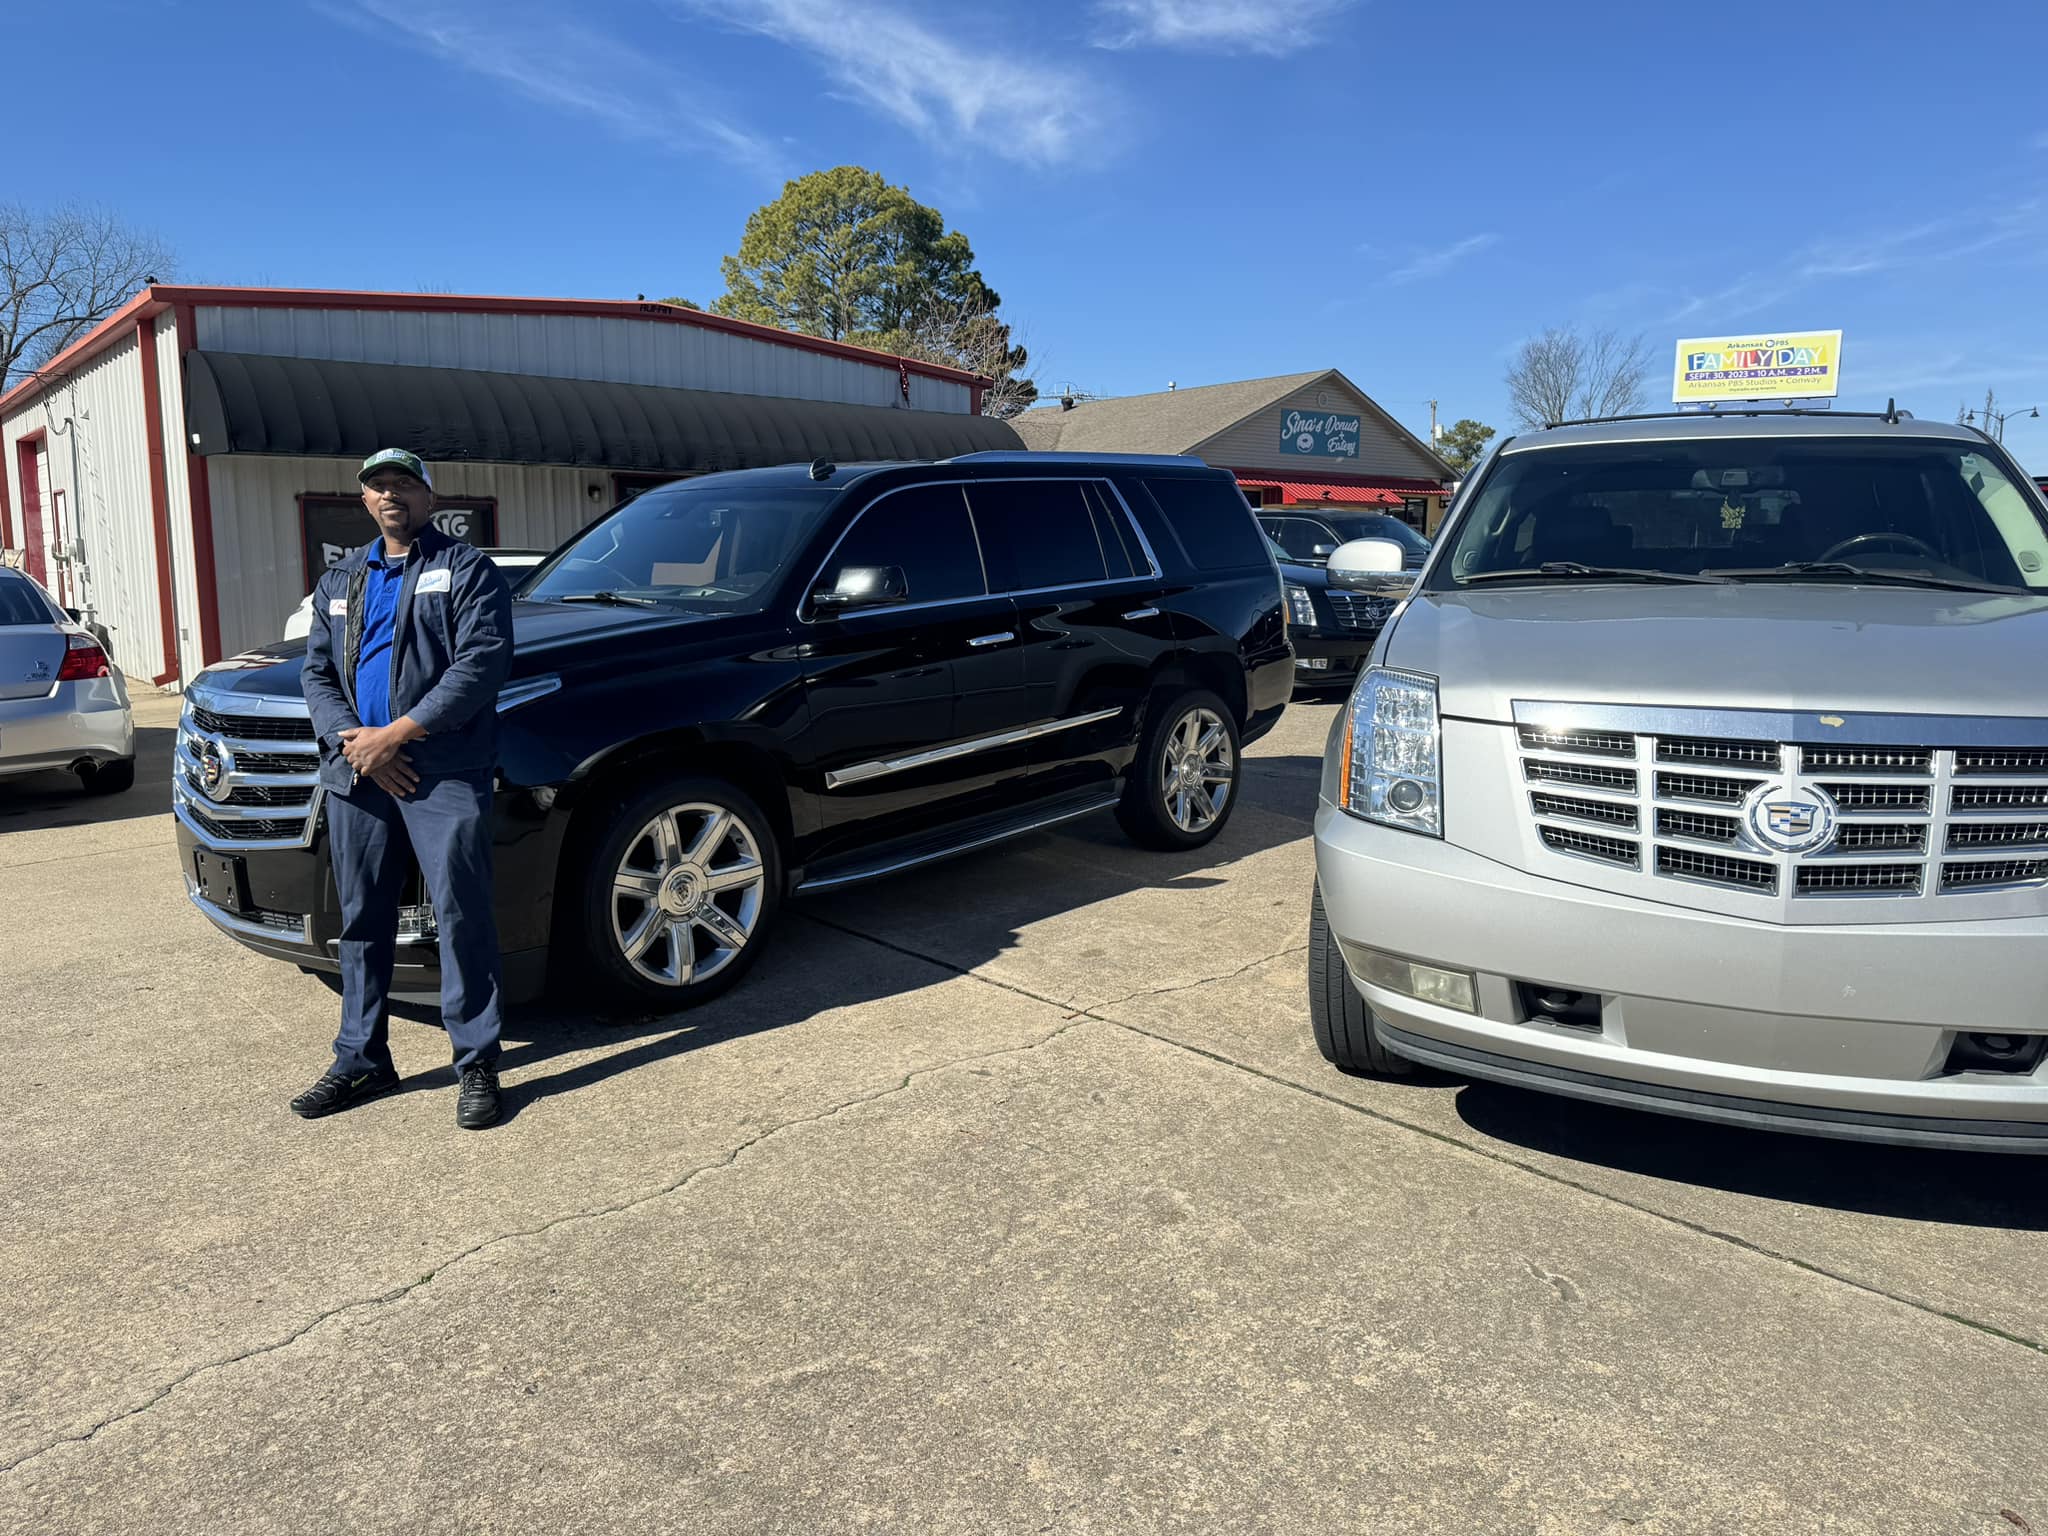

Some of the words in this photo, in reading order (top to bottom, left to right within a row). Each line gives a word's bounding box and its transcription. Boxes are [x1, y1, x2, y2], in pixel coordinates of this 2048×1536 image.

[1727, 342, 1764, 350] Arkansas
[1776, 339, 1790, 347] PBS
[1692, 350, 1773, 371] FAMILY
[1777, 346, 1823, 366] DAY
[1689, 372, 1711, 380] SEPT.
[1728, 370, 1749, 378] 2023
[1757, 369, 1767, 377] 10
[1768, 368, 1788, 377] A.M.
[1804, 367, 1822, 375] P.M.
[1689, 381, 1727, 389] Arkansas
[1746, 378, 1777, 387] Studios
[1785, 377, 1822, 385] Conway
[1281, 411, 1323, 439] Sina's
[1324, 415, 1359, 435] Donuts
[1327, 436, 1356, 457] Eatery
